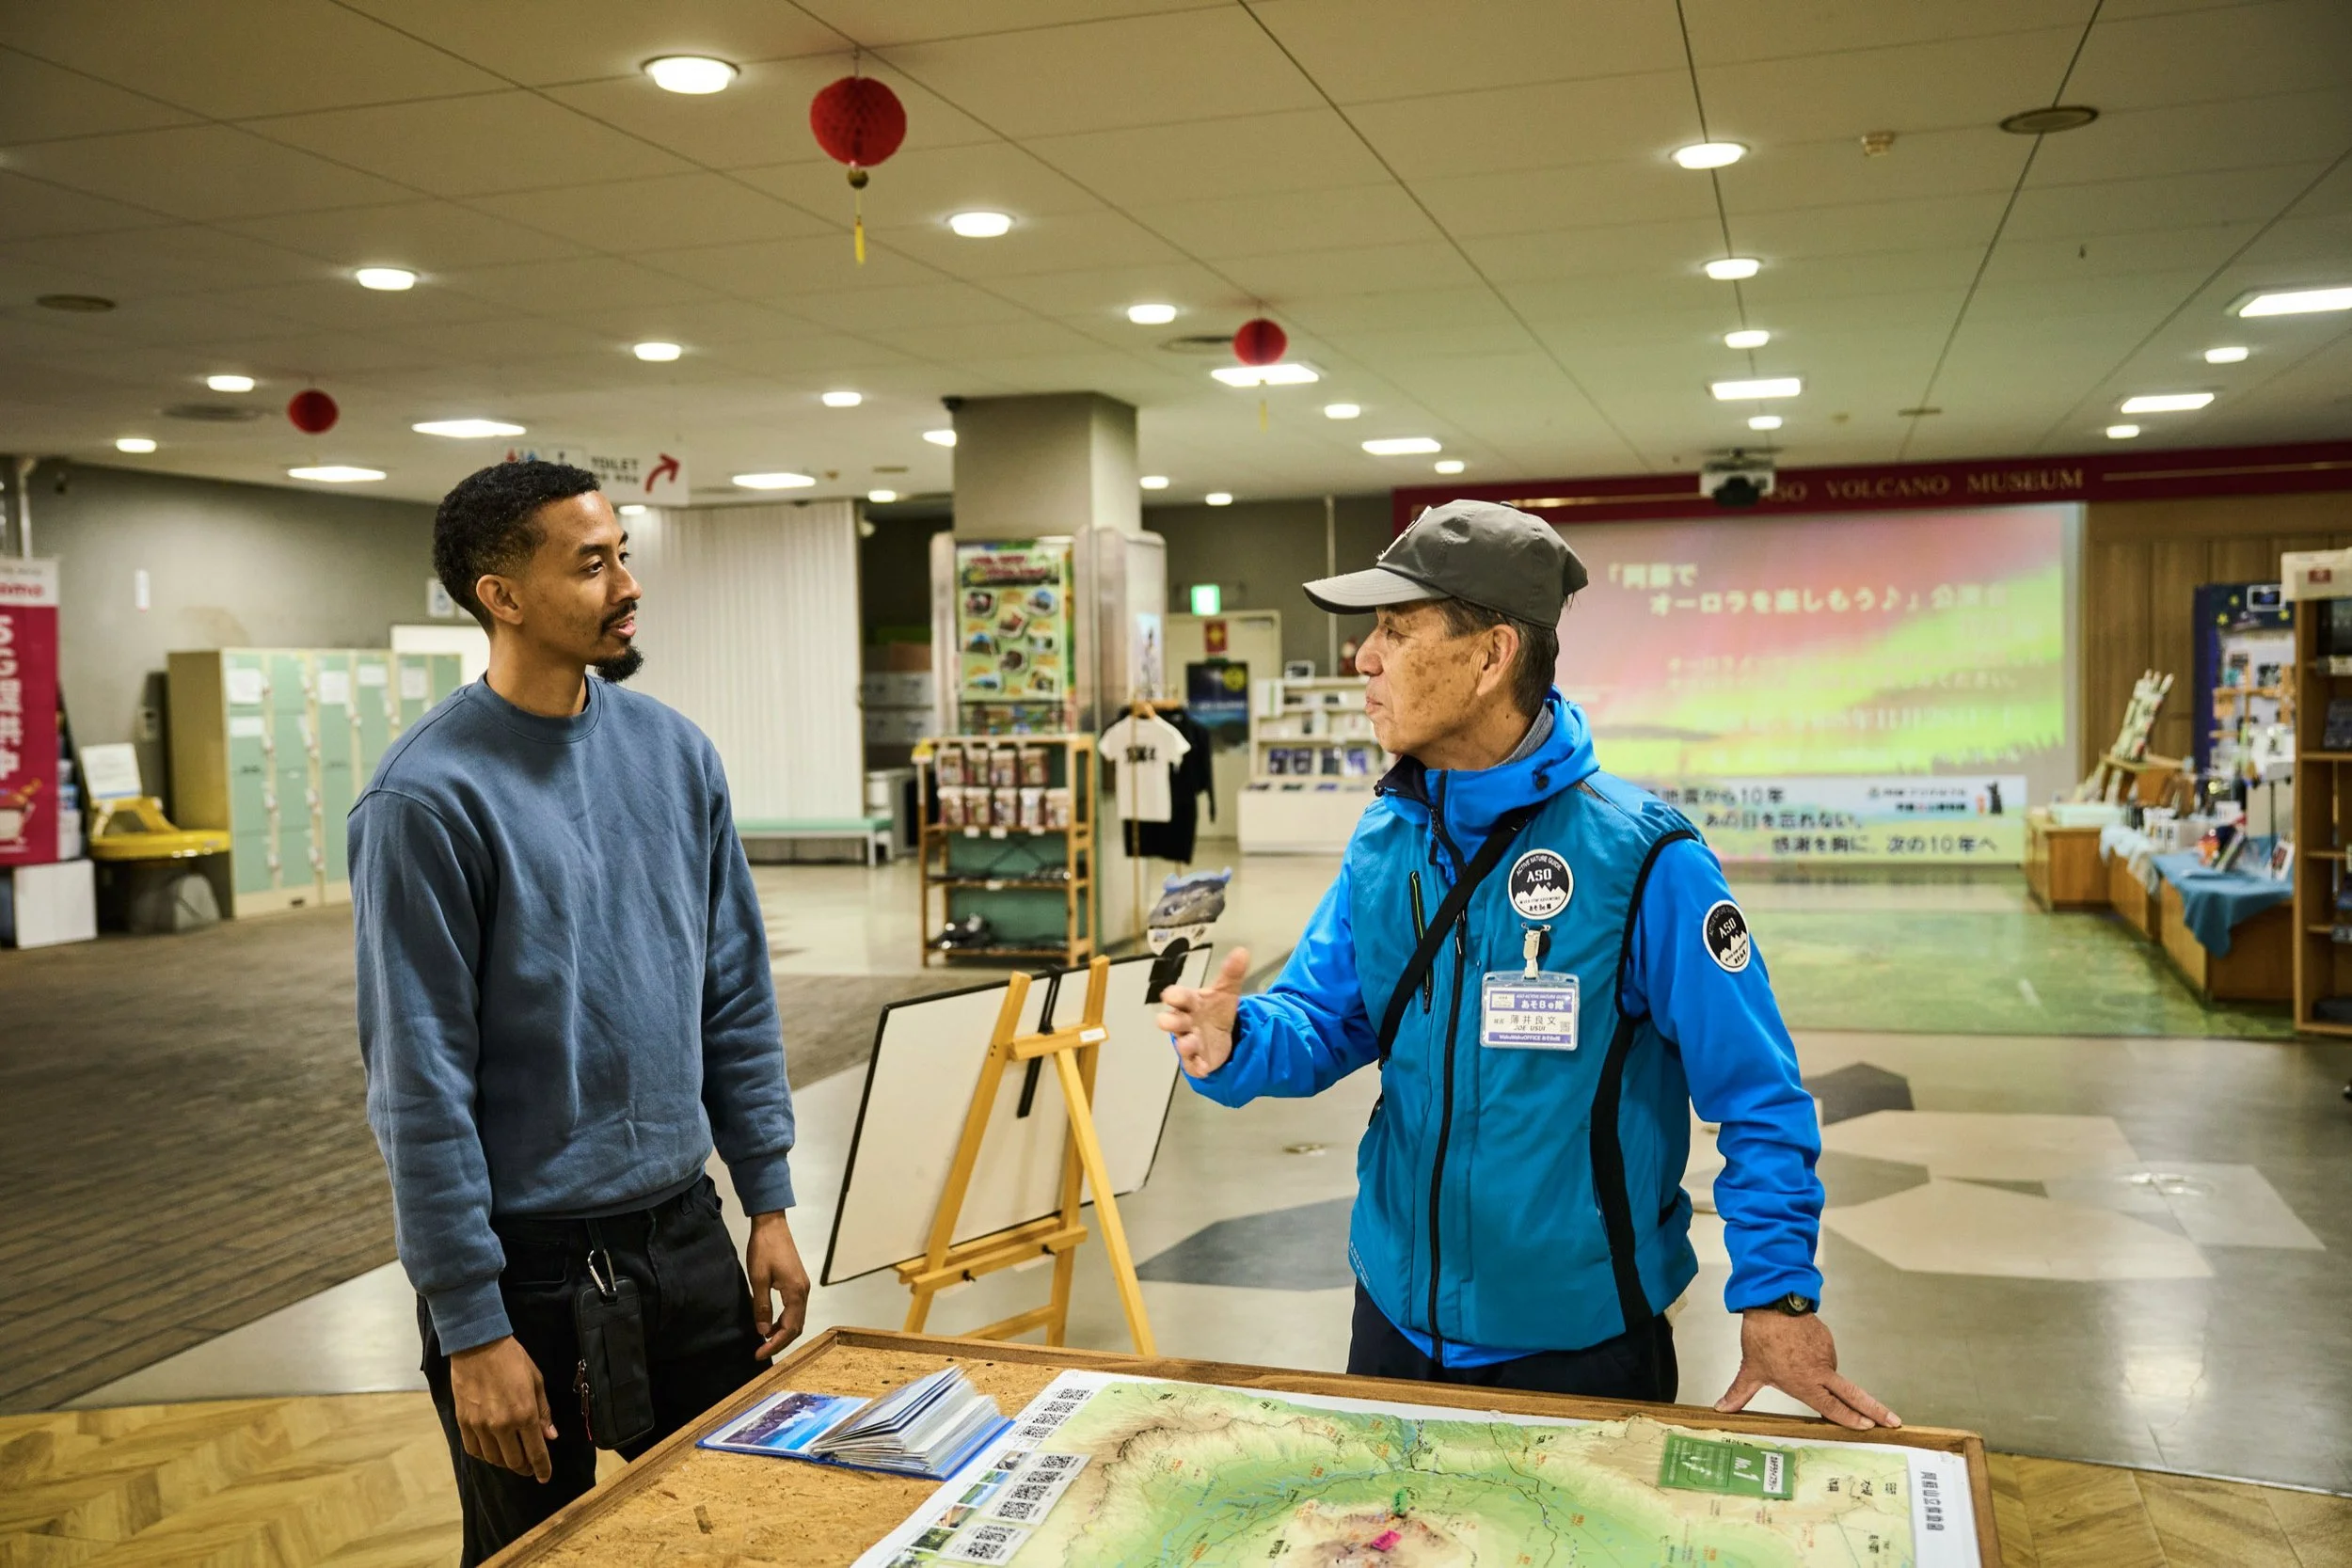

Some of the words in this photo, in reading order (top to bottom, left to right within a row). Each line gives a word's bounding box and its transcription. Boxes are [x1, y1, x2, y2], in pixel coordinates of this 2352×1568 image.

[1825, 474, 1951, 499] VOLCANO
[1967, 467, 2084, 493] MUSEUM
[1516, 859, 1531, 877] ACTIVE
[1548, 857, 1563, 872] GUIDE
[1526, 868, 1552, 883] ASO
[1719, 917, 1737, 939] ASO
